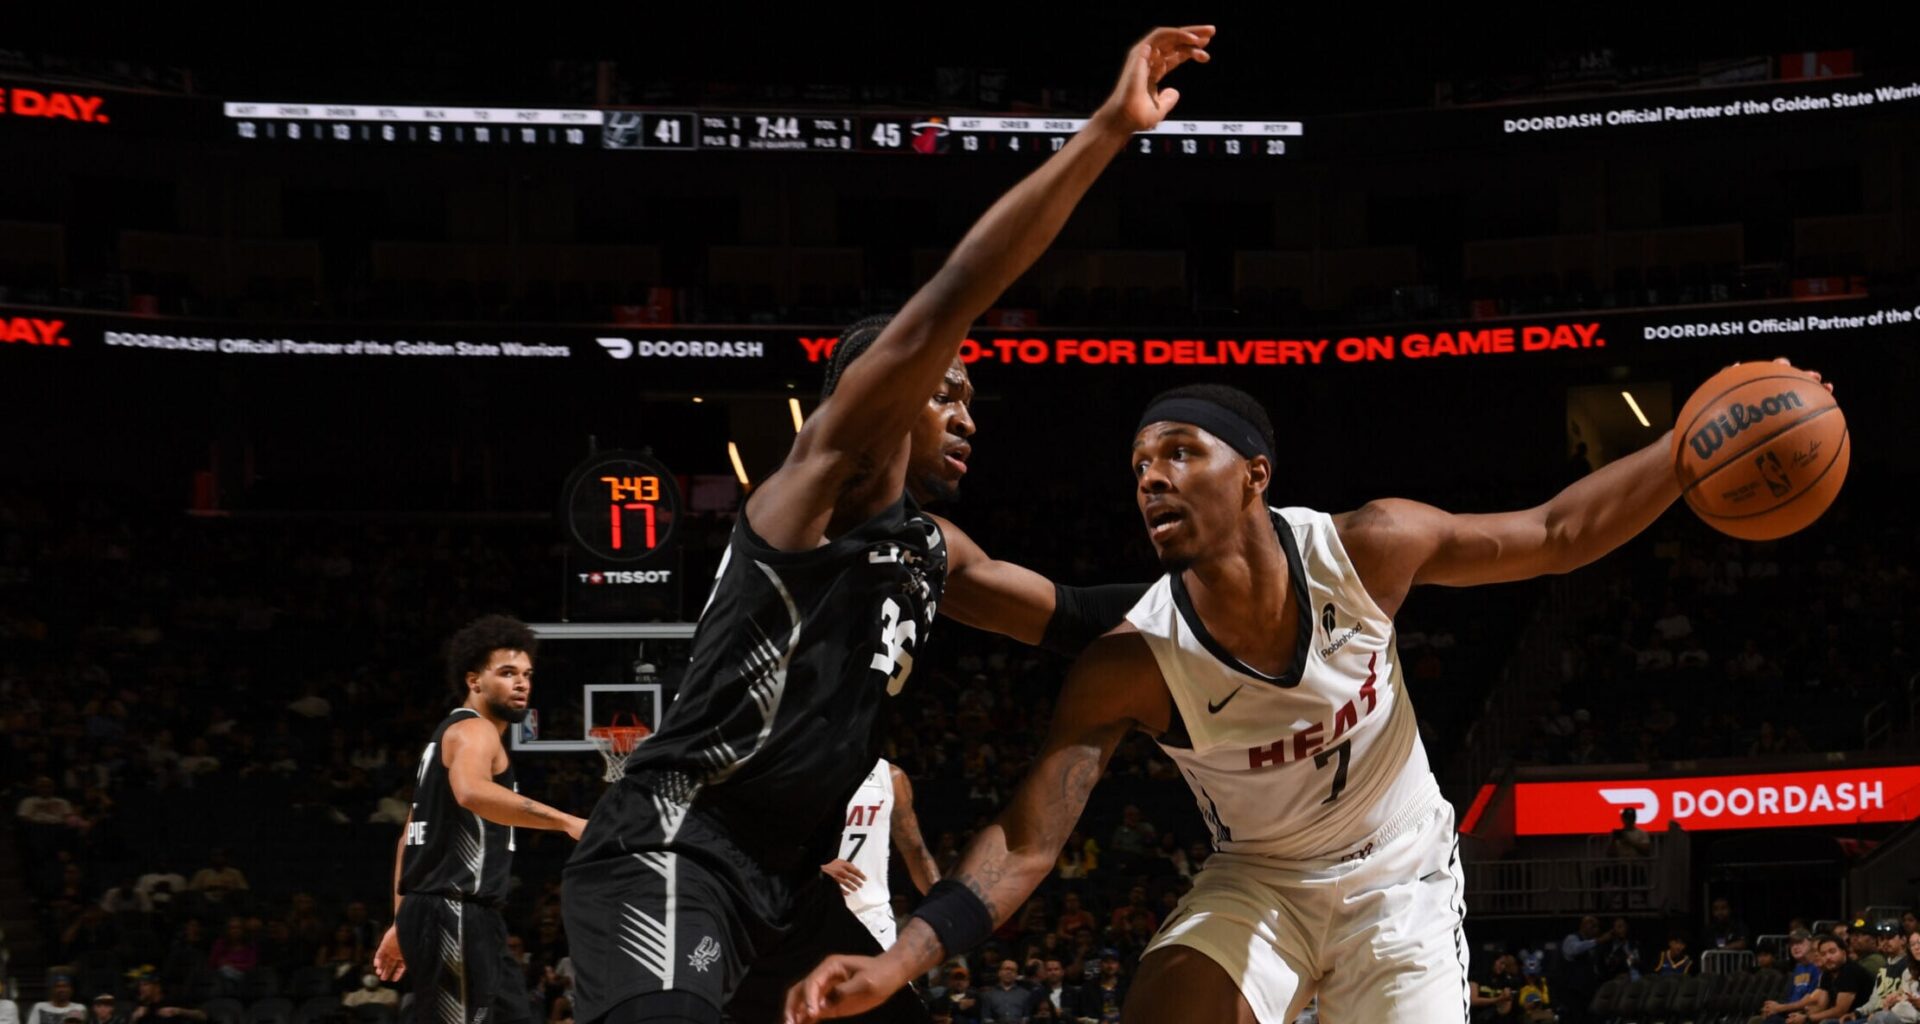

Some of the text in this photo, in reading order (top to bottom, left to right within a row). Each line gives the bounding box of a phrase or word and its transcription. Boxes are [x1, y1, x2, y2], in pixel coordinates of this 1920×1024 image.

[11, 88, 109, 124] DAY.
[1504, 113, 1602, 133] DOORDASH
[1606, 107, 1662, 125] Official
[1664, 103, 1722, 121] Partner
[1724, 104, 1741, 116] of
[1743, 100, 1770, 115] the
[1772, 95, 1831, 113] Golden
[1832, 92, 1874, 108] State
[654, 119, 680, 143] 41
[756, 116, 800, 138] 7:44
[871, 123, 900, 147] 45
[1009, 137, 1019, 151] 4
[1141, 138, 1151, 154] 2
[0, 317, 70, 347] AY.
[1644, 321, 1744, 340] DOORDASH
[1747, 317, 1805, 334] Official
[1807, 314, 1865, 331] Partner
[1867, 310, 1884, 326] of
[1885, 308, 1912, 324] the
[104, 331, 570, 357] DOORDASH Official Partner of the Golden State Warriors
[638, 340, 763, 358] DOORDASH
[960, 323, 1605, 365] O-TO FOR DELIVERY ON GAME DAY.
[1689, 390, 1804, 460] Wilson
[600, 476, 660, 501] 7:43
[610, 503, 656, 550] 17
[603, 570, 671, 584] TISSOT
[1321, 621, 1363, 659] Robinhood
[1248, 651, 1378, 769] HEAT
[1313, 739, 1352, 805] 7
[846, 800, 885, 827] AT
[1672, 780, 1884, 818] DOORDASH
